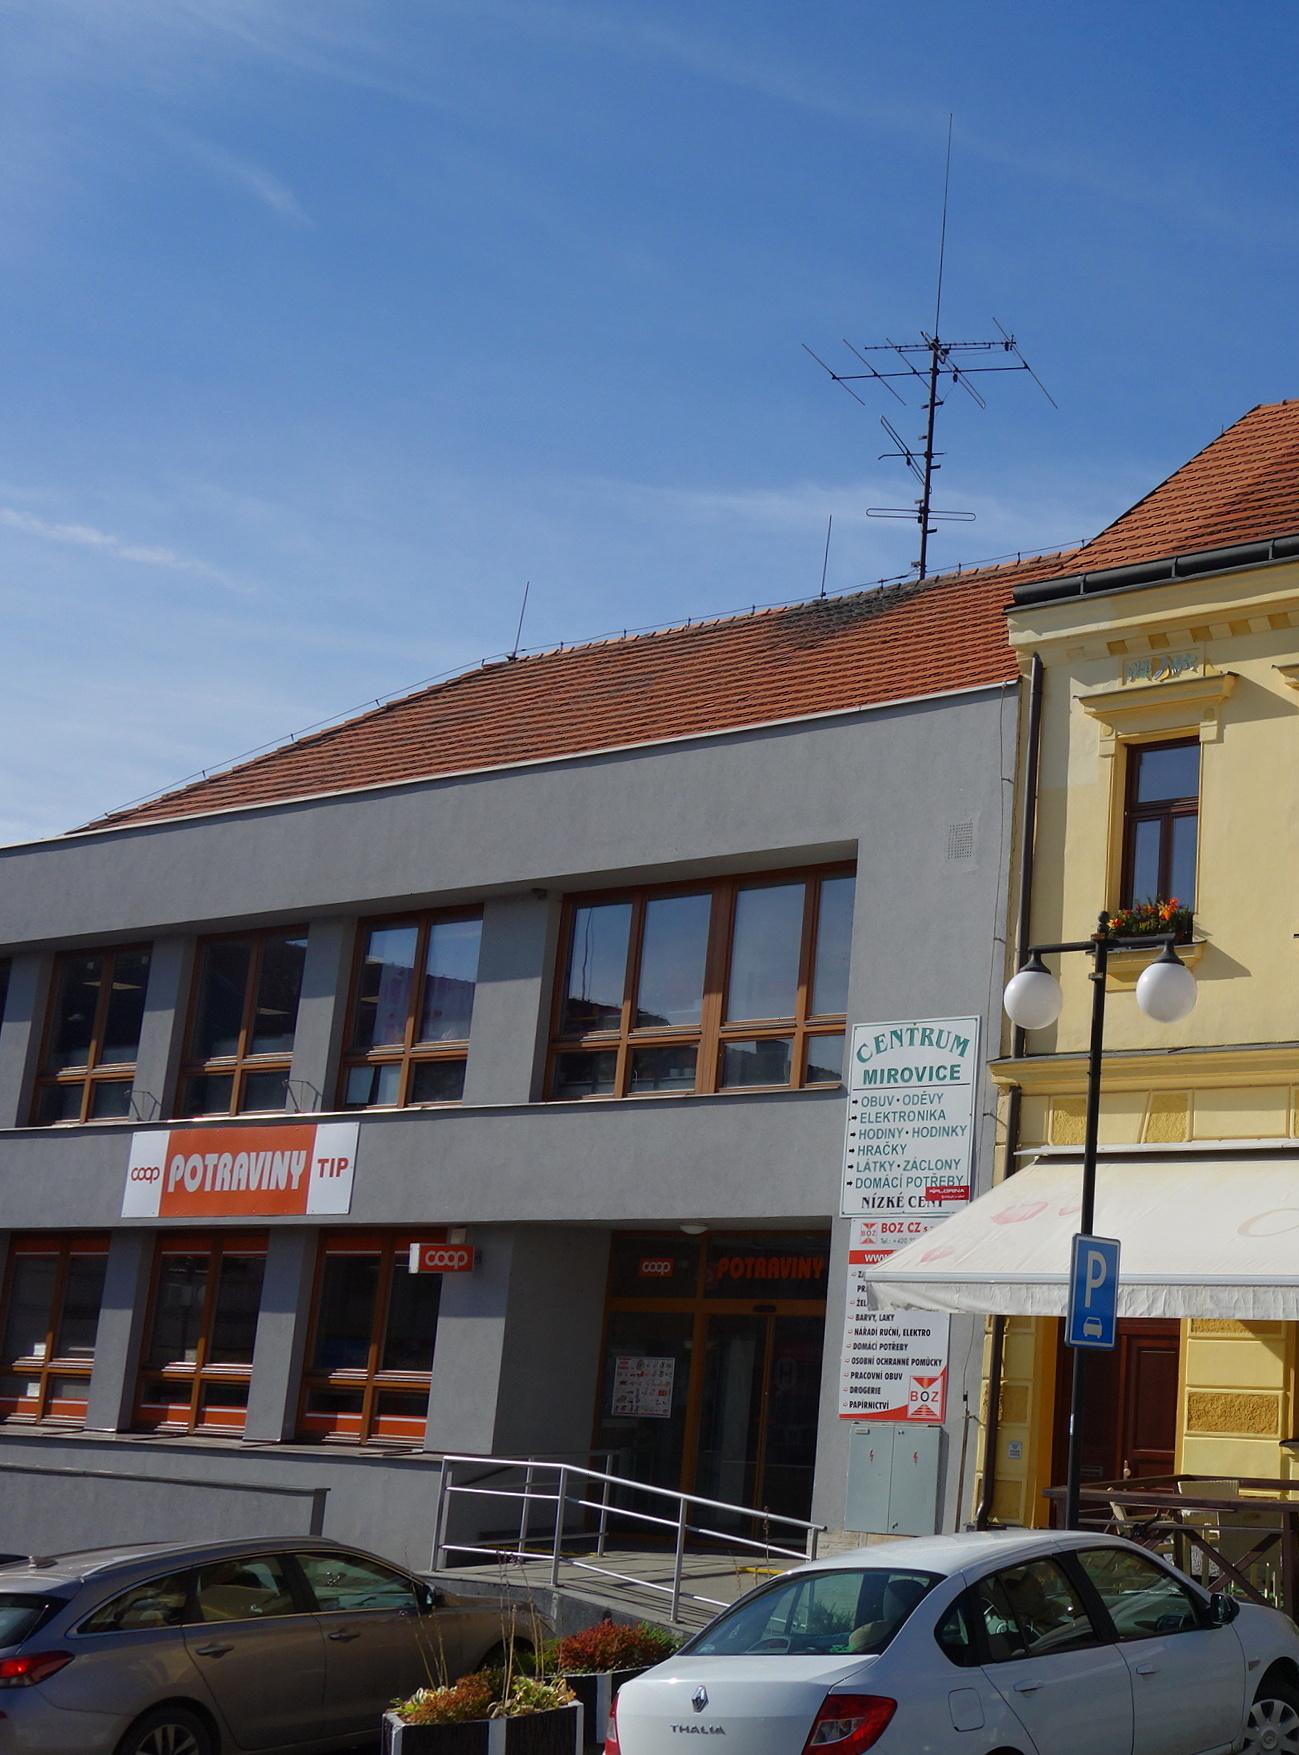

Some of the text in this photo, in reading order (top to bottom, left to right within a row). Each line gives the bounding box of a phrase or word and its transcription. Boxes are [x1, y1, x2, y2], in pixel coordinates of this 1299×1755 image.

[855, 1026, 970, 1064] CENTRUM
[863, 1064, 961, 1086] MIROVICE
[861, 1095, 895, 1108] OBUV
[859, 1108, 946, 1124] ELEKTRONIKA
[858, 1125, 968, 1140] HODINY HODINKY
[857, 1141, 907, 1156] HRAČKY
[130, 1150, 349, 1193] coop POTRAVINY TIP
[856, 1156, 962, 1173] LÁTKY ZÁCLONY
[855, 1173, 903, 1189] DOMÁCÍ
[861, 1192, 905, 1209] NÍZKÉ
[881, 1222, 904, 1233] BOZ
[907, 1221, 921, 1233] CZ
[424, 1250, 468, 1269] coop
[642, 1261, 671, 1275] coop
[717, 1256, 823, 1280] POTRAVINY
[902, 1328, 931, 1337] ELEKTRO
[884, 1372, 903, 1381] OBUV
[849, 1386, 881, 1395] DROGERIE
[910, 1390, 939, 1403] BOZ
[671, 1724, 727, 1736] THALIA
